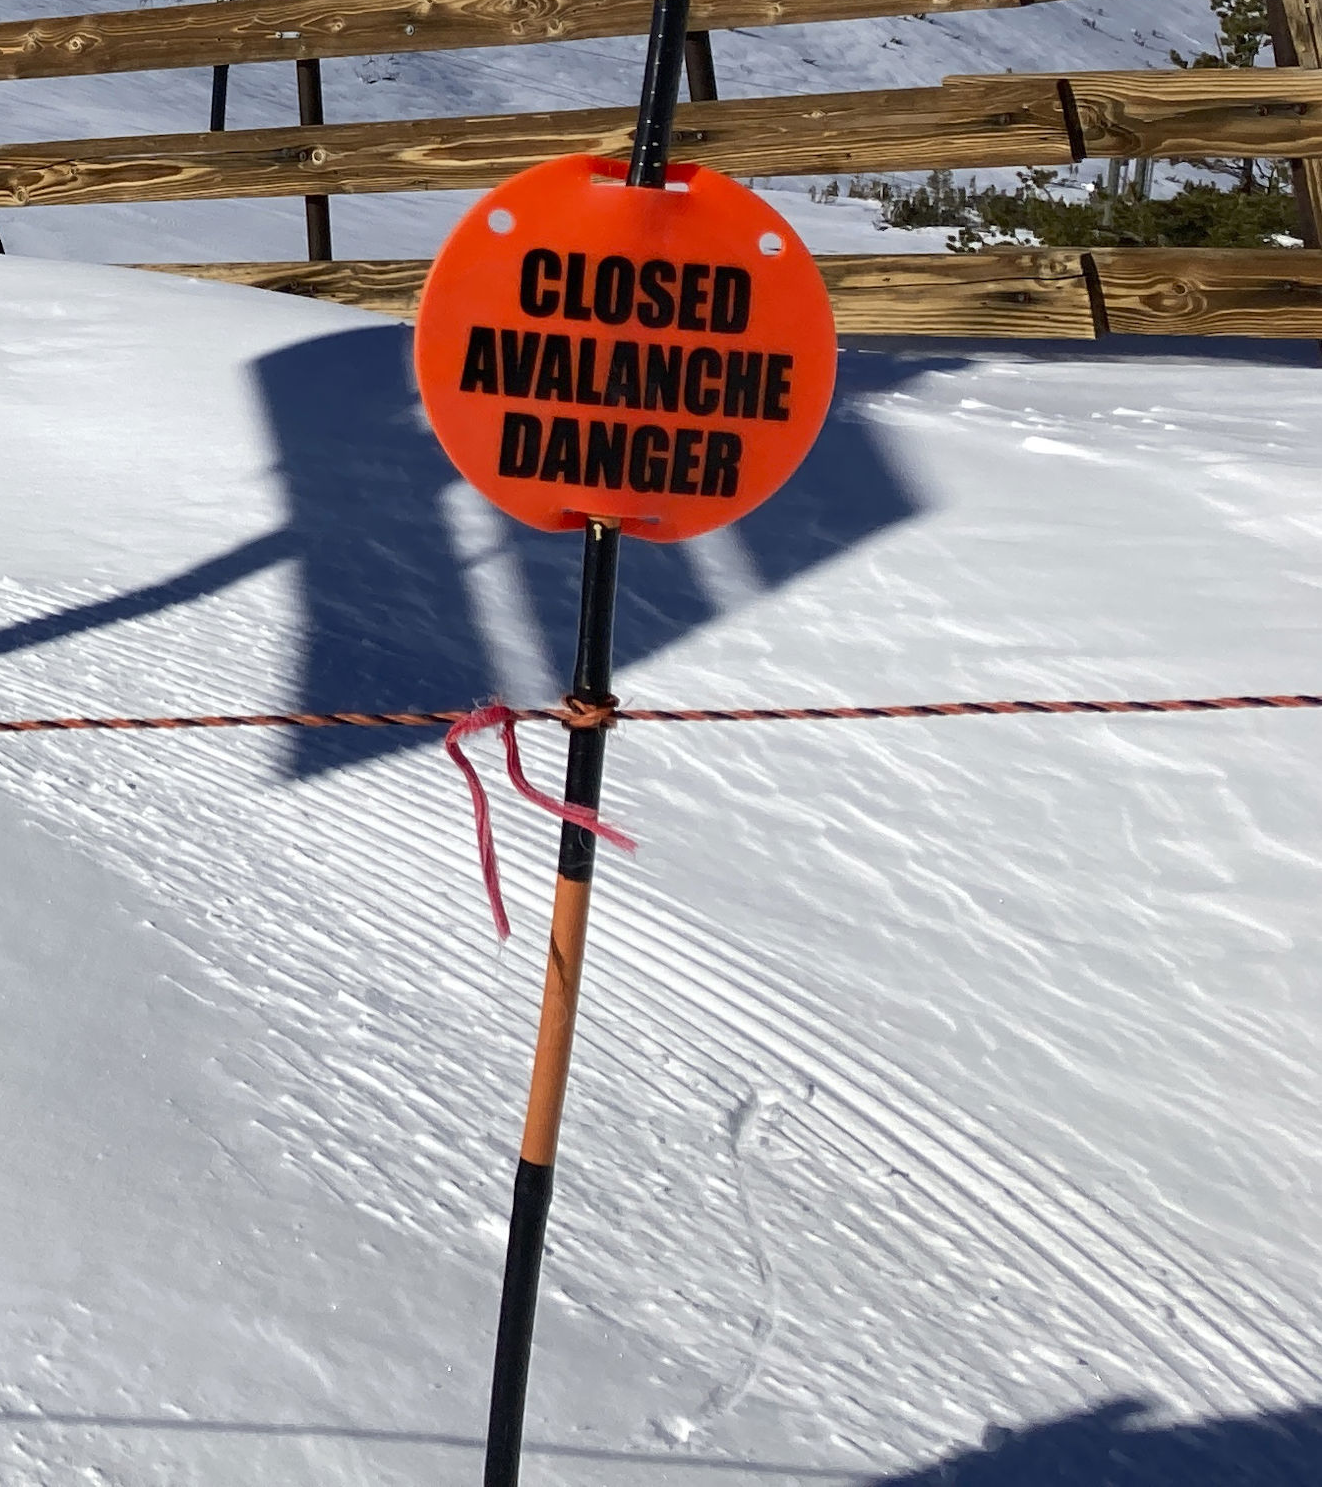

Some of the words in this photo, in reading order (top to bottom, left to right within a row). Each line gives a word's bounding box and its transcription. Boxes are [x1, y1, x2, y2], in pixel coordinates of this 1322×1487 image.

[520, 249, 751, 334] CLOSED
[460, 327, 793, 421] AVALANCHE
[499, 412, 742, 497] DANGER
